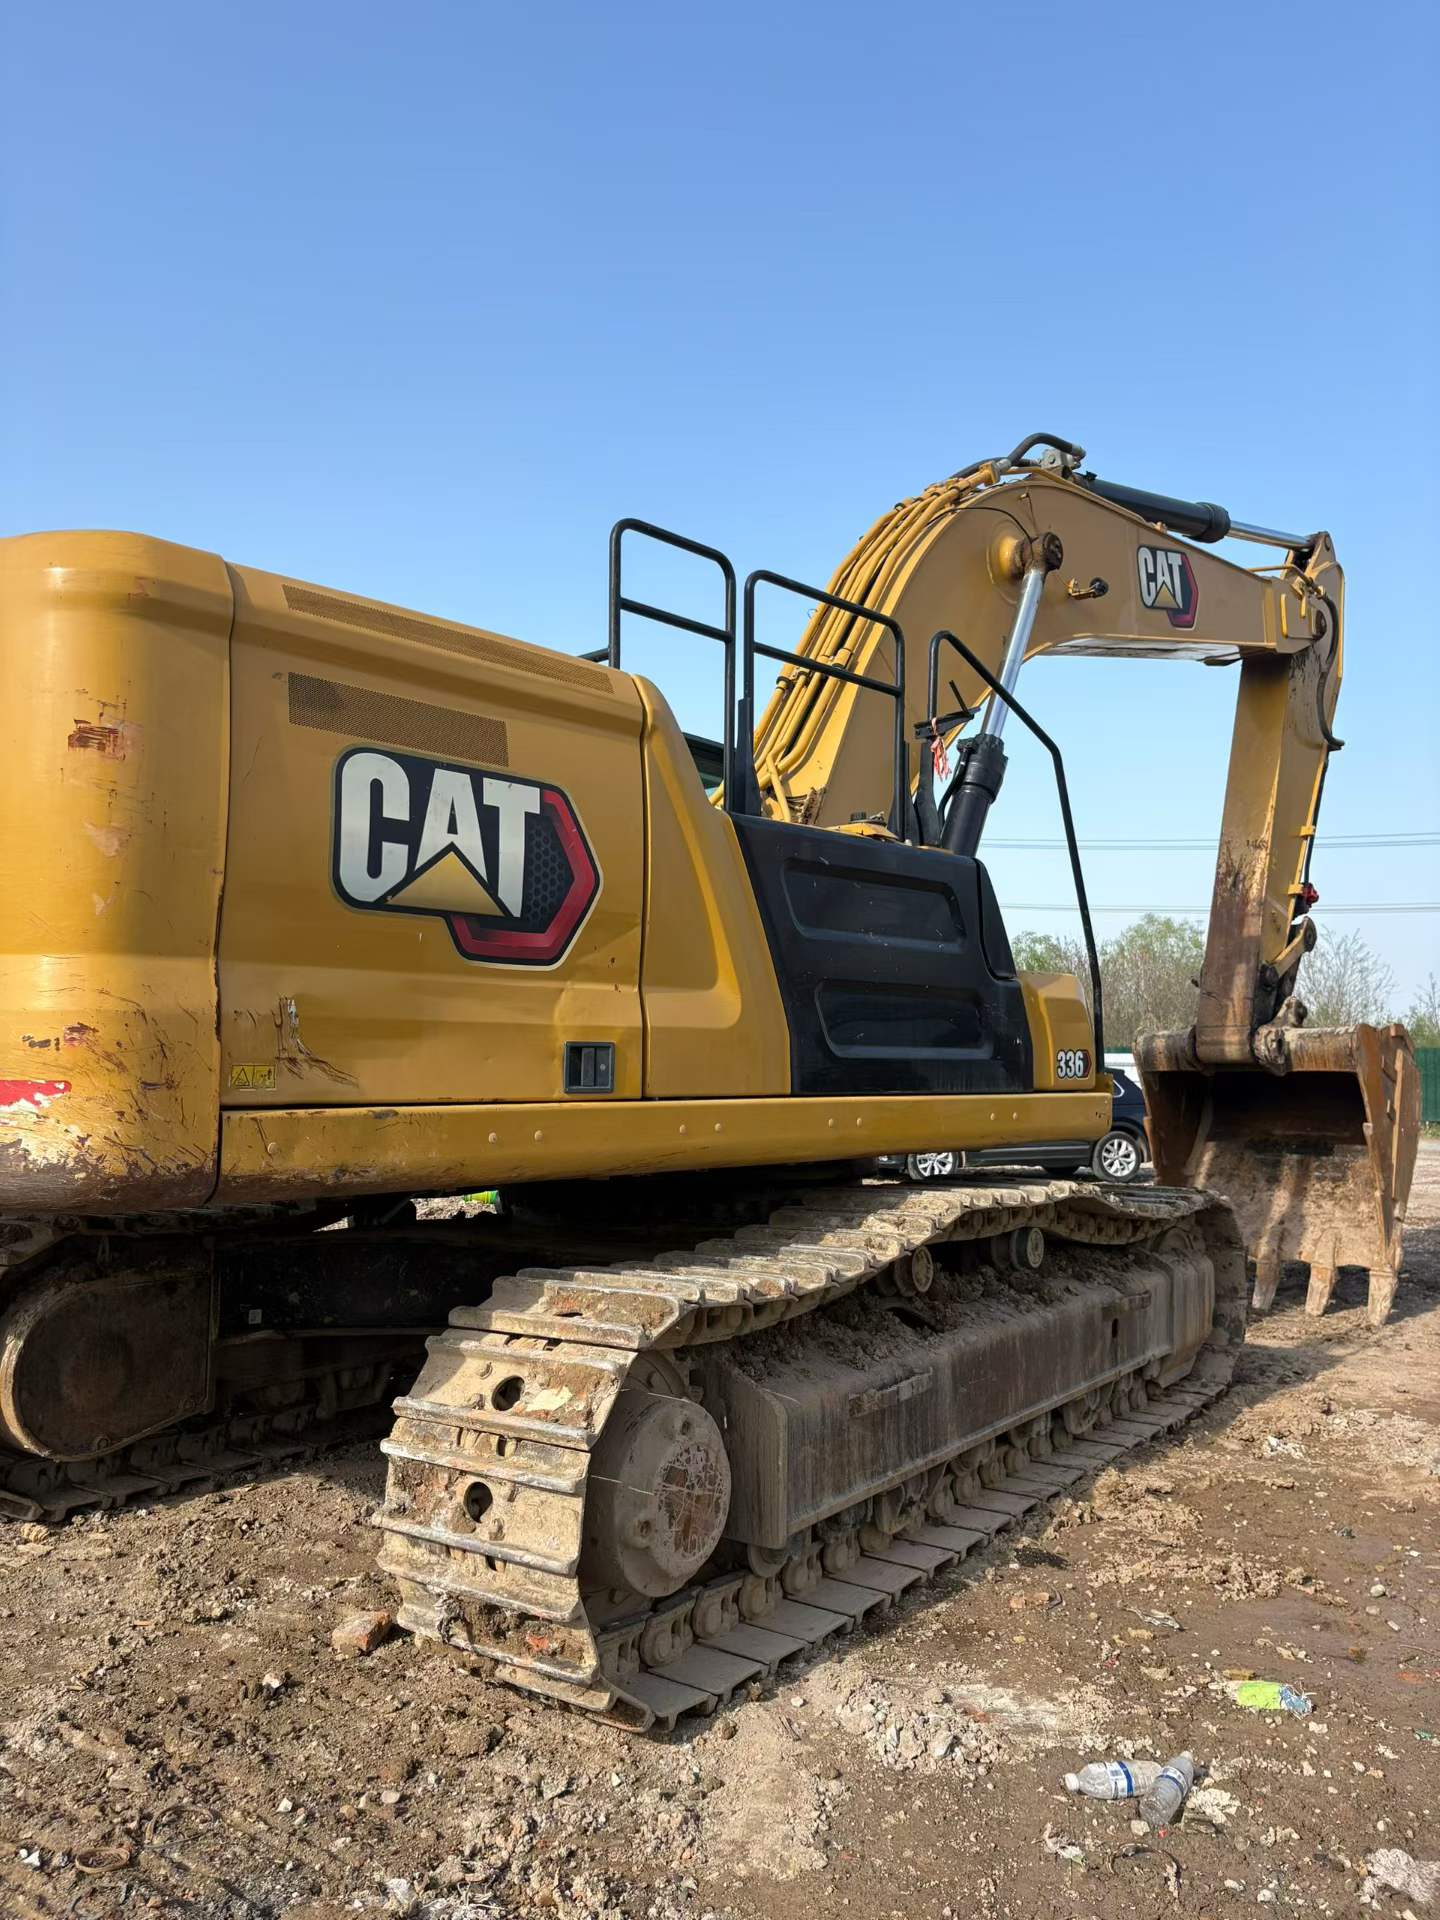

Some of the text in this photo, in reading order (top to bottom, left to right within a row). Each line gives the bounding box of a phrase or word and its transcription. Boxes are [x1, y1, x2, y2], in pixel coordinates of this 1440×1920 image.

[1138, 547, 1183, 609] CAT
[339, 752, 541, 918] CAT
[1057, 1050, 1084, 1078] 336
